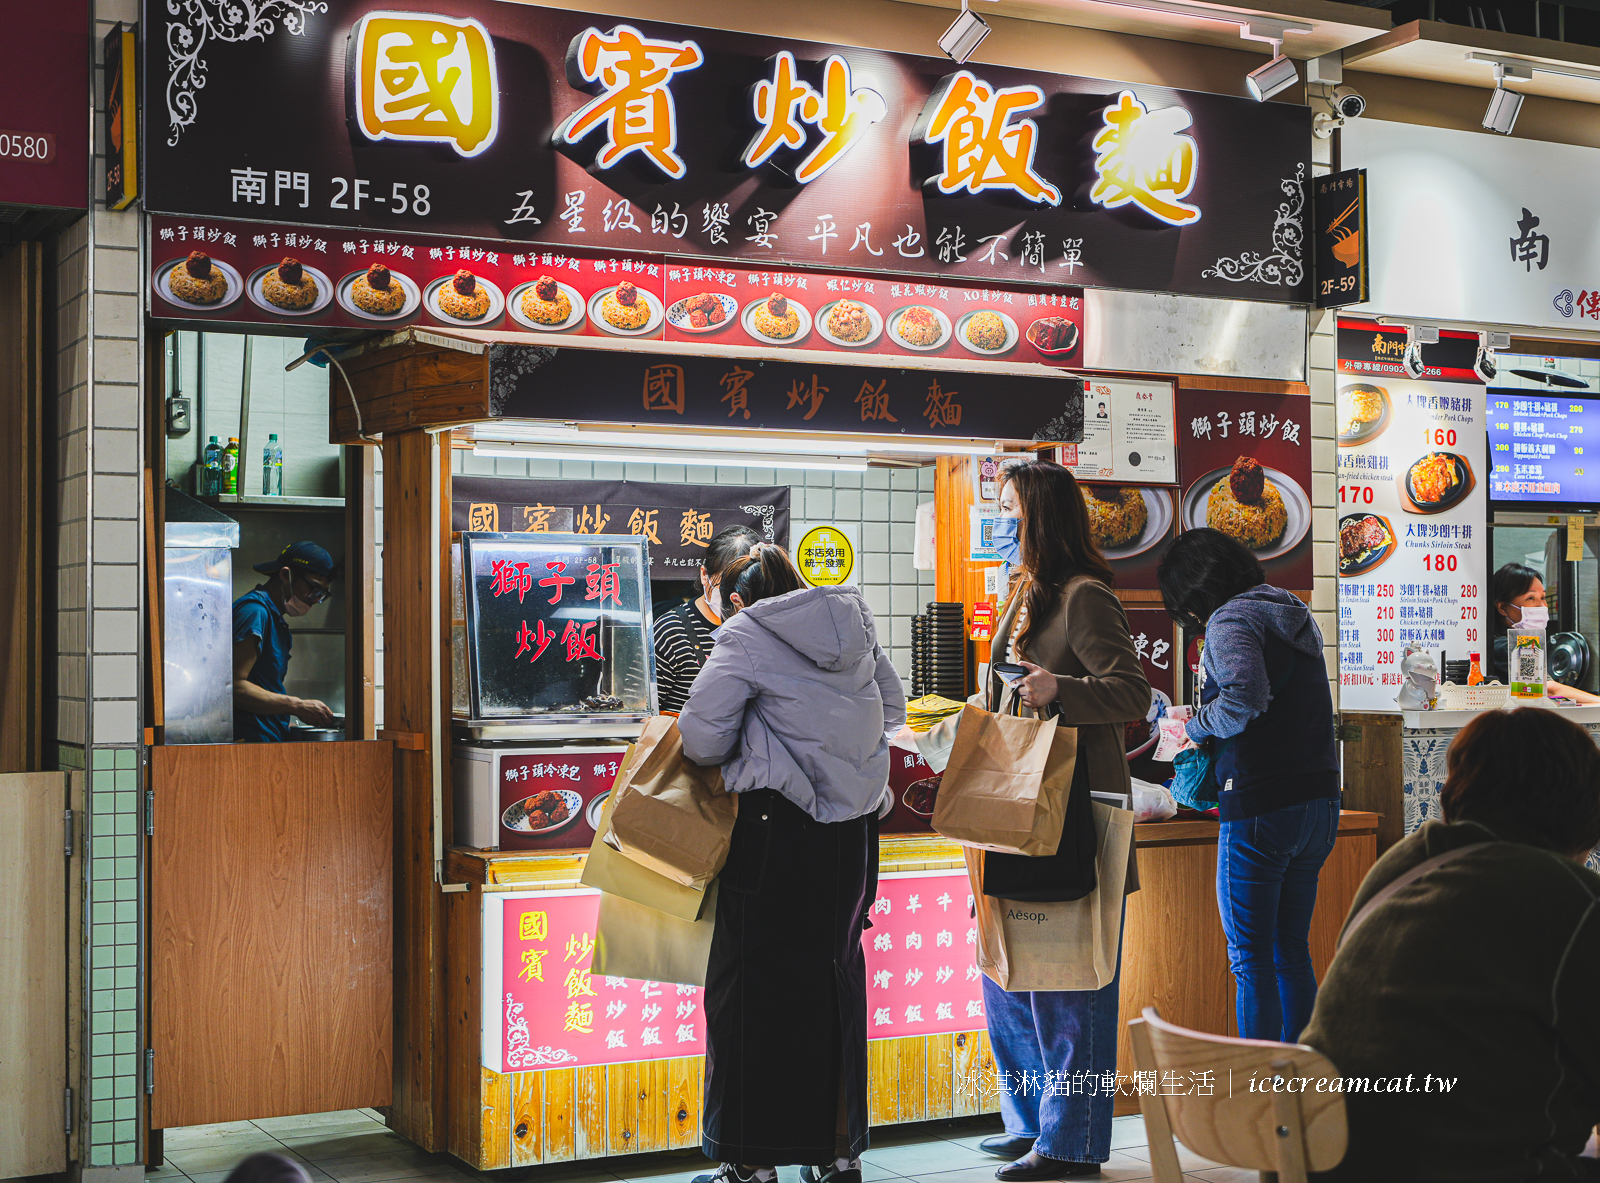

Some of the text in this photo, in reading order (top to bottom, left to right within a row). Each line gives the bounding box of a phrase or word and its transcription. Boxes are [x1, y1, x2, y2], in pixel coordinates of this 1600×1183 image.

[350, 10, 1203, 226] 國賓炒飯麵
[0, 134, 48, 159] 0580
[230, 167, 432, 217] 南門 2F-58
[159, 225, 237, 248] 獅子頭炒飯
[253, 232, 327, 254] 獅子頭炒飯
[807, 213, 1084, 275] 平凡也能不簡單
[1509, 207, 1550, 273] 南
[342, 239, 415, 260] 獅子頭炒飯
[429, 246, 499, 267] 獅子頭炒飯
[513, 252, 581, 272] 獅子頭炒飯
[593, 258, 660, 278] 獅子頭炒飯
[747, 273, 808, 290] 獅子頭炒飯
[826, 279, 875, 294] 蝦仁炒飯
[1321, 275, 1356, 295] 2F-59
[1372, 333, 1408, 355] 南門牛
[1344, 360, 1442, 376] 外帶專線/0902--266
[642, 363, 963, 429] 國賓炒飯麵
[1495, 401, 1509, 409] 170
[1444, 413, 1457, 421] Pork
[1457, 414, 1474, 424] Chops
[1569, 405, 1583, 413] 280
[1190, 411, 1301, 446] 獅子頭炒飯
[1495, 422, 1509, 430] 160
[1423, 428, 1457, 446] 160
[1338, 485, 1374, 504] 170
[804, 547, 845, 557] 本店免用
[1405, 540, 1430, 548] Chunks
[1431, 541, 1453, 549] Sirloin
[663, 557, 706, 567] 平凡也能不
[804, 558, 846, 568] 統一發票
[1422, 553, 1458, 572] 180
[489, 559, 623, 606] 獅子頭
[1377, 584, 1395, 597] 250
[1461, 584, 1478, 598] 280
[1377, 606, 1395, 619] 210
[1461, 606, 1478, 619] 270
[514, 619, 606, 663] 炒飯
[1377, 628, 1395, 642] 300
[1466, 628, 1478, 641] 90
[1377, 651, 1395, 664] 290
[505, 761, 581, 782] 獅子頭冷凍包
[593, 761, 619, 778] 獅子
[518, 910, 549, 984] 國賓
[935, 891, 955, 1020] 牛肉炒飯
[872, 896, 894, 1026] 肉絲燴飯
[904, 893, 925, 1023] 羊肉炒飯
[563, 931, 598, 1034] 炒飯麵
[640, 978, 663, 1047] 仁炒飯
